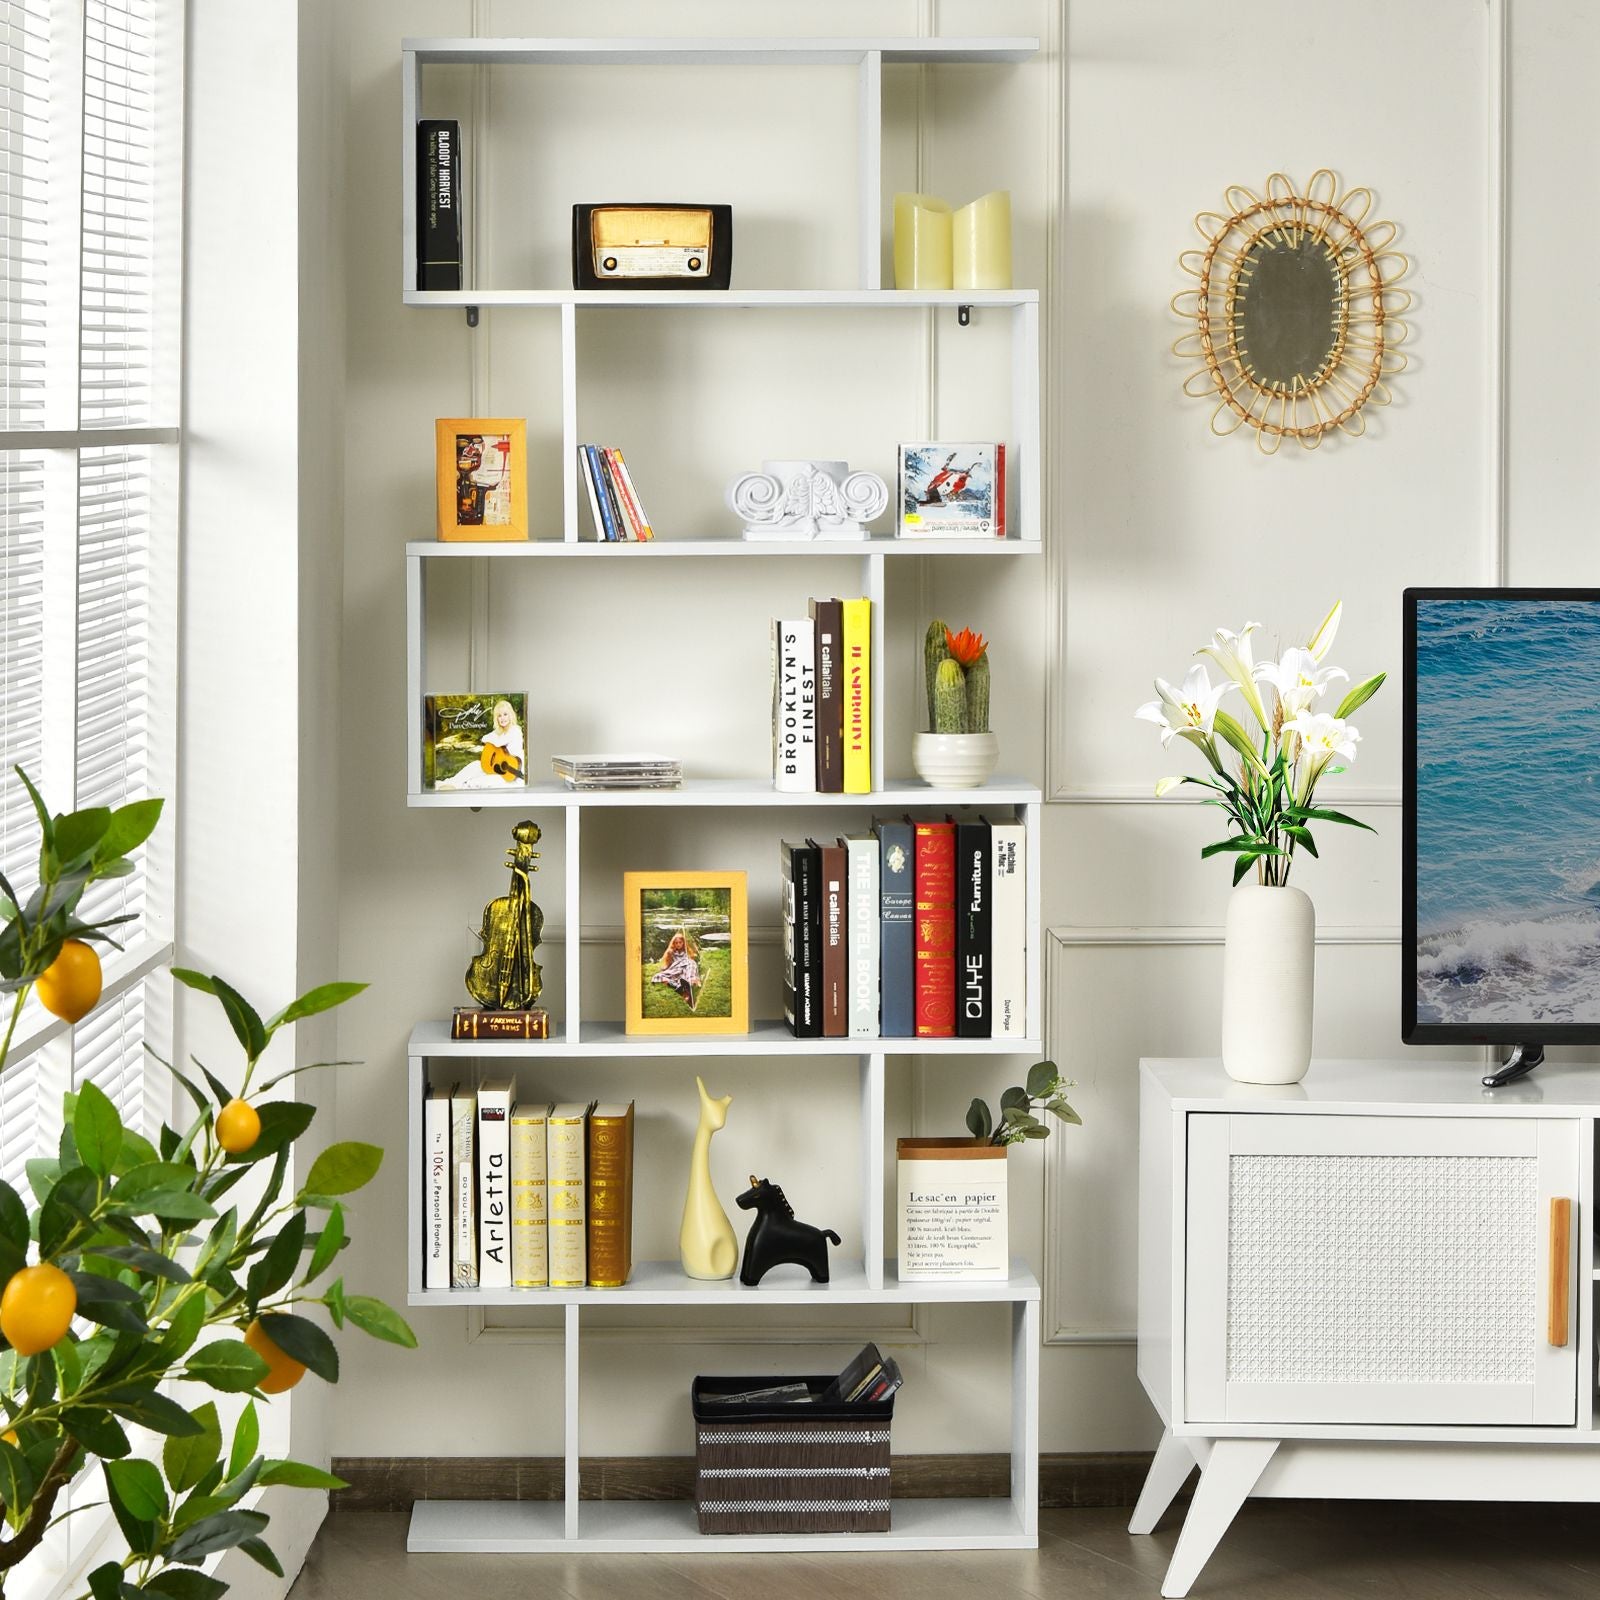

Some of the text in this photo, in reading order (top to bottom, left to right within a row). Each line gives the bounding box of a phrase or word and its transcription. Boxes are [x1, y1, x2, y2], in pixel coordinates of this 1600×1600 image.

[438, 131, 451, 209] BLOODY HARVEST
[785, 634, 796, 774] BROOKLYN'S
[802, 665, 814, 743] FINEST
[856, 852, 871, 889] THE
[998, 853, 1007, 867] Mac
[1006, 842, 1017, 874] Switching
[971, 850, 982, 912] Furniture
[856, 893, 871, 955] HOTEL
[856, 960, 871, 1012] BOOK
[501, 1024, 520, 1032] ARMS
[1002, 999, 1012, 1031] David Pogue
[433, 1150, 444, 1177] 10Ks
[462, 1176, 468, 1189] DO
[910, 1192, 923, 1202] Le
[944, 1194, 957, 1202] en
[964, 1192, 996, 1205] papier
[433, 1185, 442, 1221] Personal
[484, 1153, 504, 1264] Arletta
[432, 1224, 442, 1259] Branding
